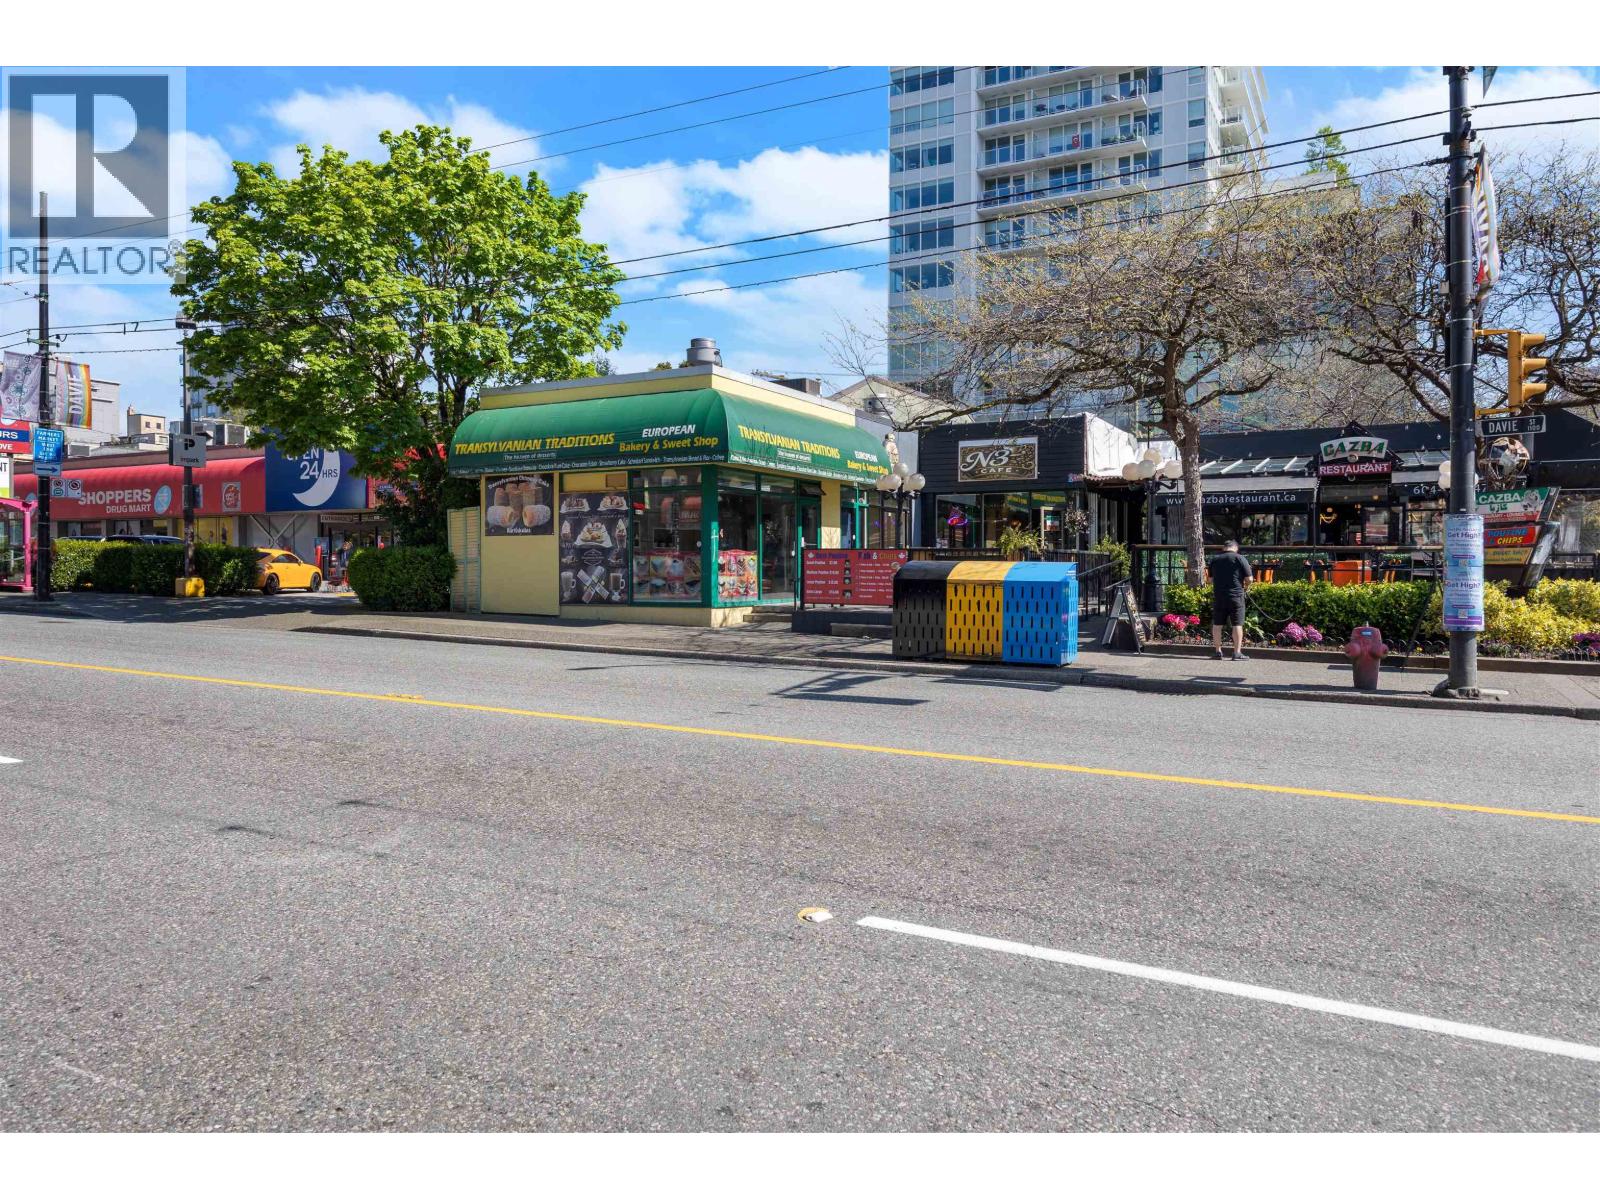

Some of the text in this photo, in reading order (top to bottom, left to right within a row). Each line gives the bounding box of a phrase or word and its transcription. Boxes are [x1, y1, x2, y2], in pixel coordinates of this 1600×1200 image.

[1488, 420, 1518, 433] DAVIE
[1529, 418, 1536, 426] ST
[642, 424, 696, 438] EUROPEAN
[455, 433, 615, 454] TRANSYLVANIAN TRADITIONS
[619, 436, 719, 454] Bakery & Sweet Shop
[738, 425, 801, 451] TRANSYLVANIAN
[801, 441, 840, 459] TRADITIONS
[854, 450, 878, 462] EUROPEAN
[300, 461, 319, 480] 24
[847, 460, 862, 472] Bakery
[1320, 463, 1389, 475] RESTAURANT
[322, 468, 338, 478] HRS
[78, 488, 151, 505] SHOPPERS
[1479, 492, 1521, 505] CAZBA
[106, 504, 151, 513] DRUG MART
[1461, 531, 1480, 539] High?
[1487, 527, 1528, 537] POUTINE
[1497, 537, 1523, 545] CHIPS
